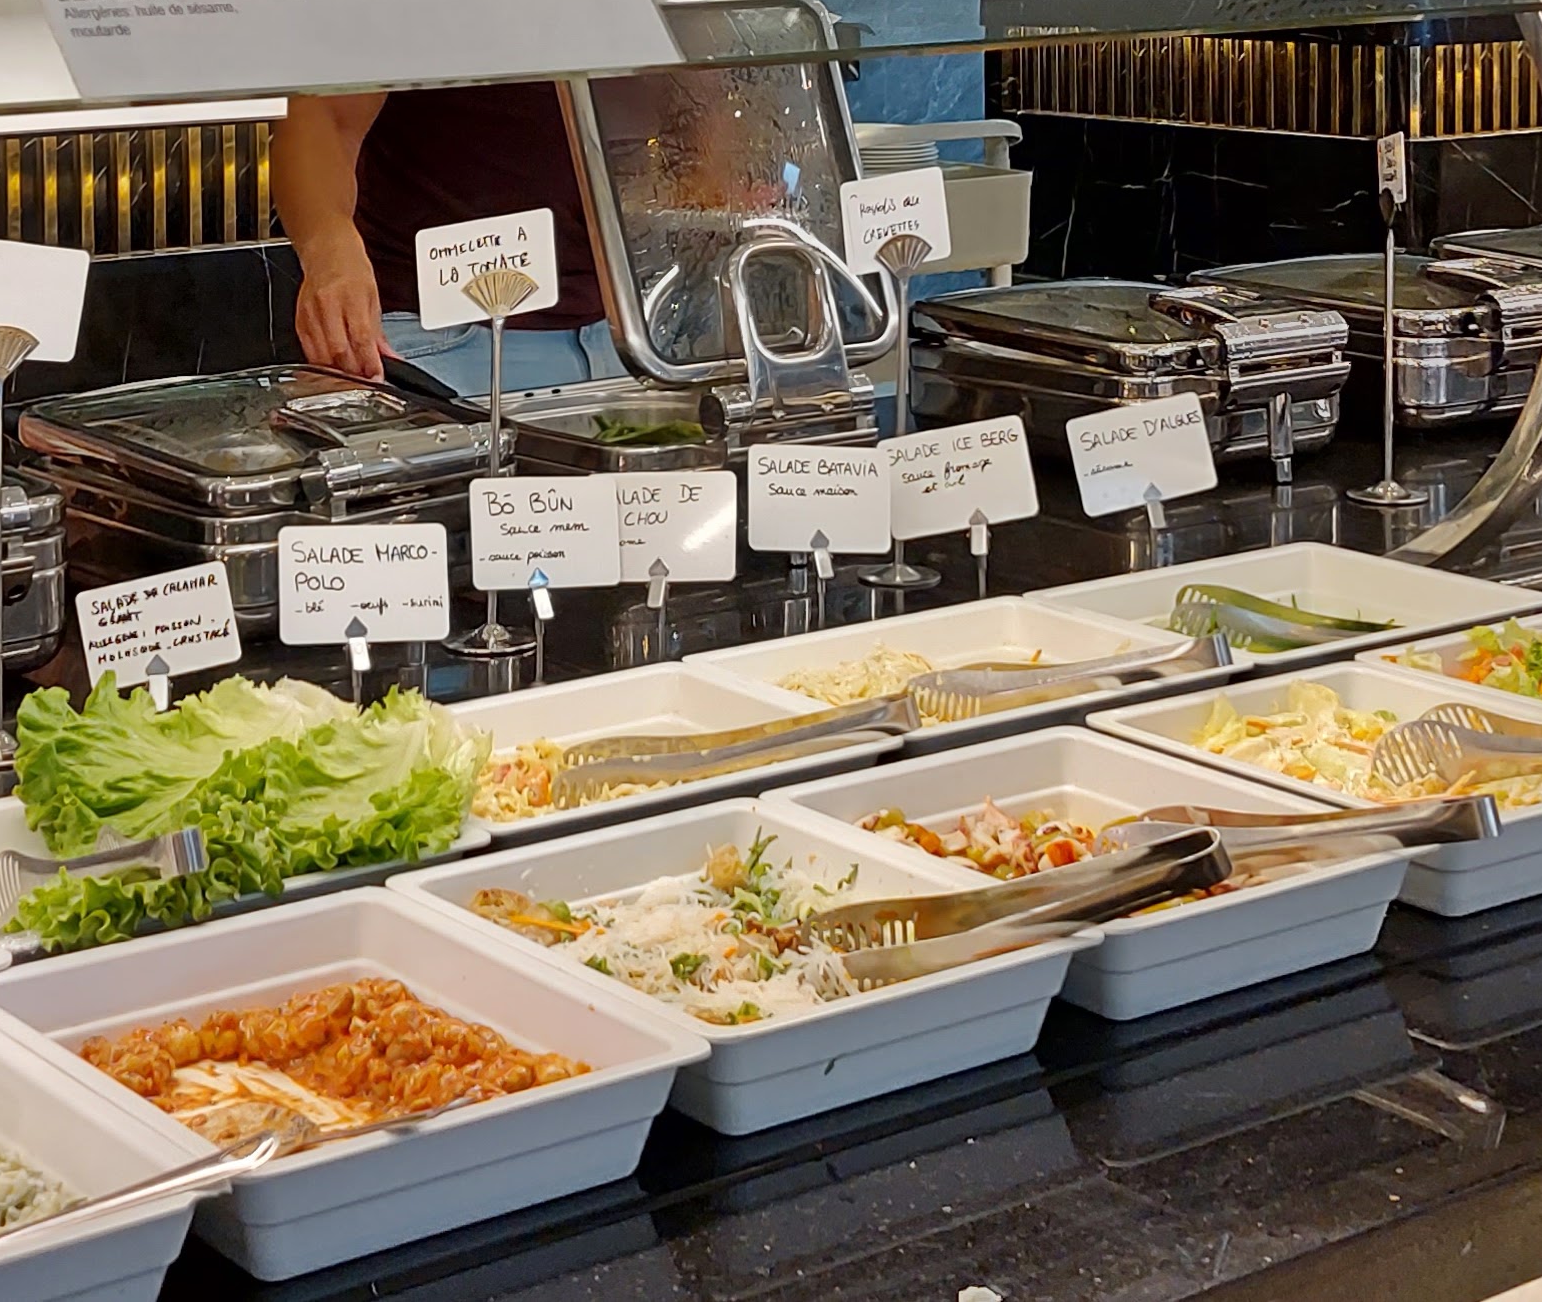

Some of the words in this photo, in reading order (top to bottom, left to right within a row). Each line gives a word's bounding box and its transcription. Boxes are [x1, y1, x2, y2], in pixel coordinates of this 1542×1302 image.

[133, 4, 167, 17] huile
[168, 3, 185, 16] de
[69, 24, 132, 38] moutarde
[517, 225, 528, 242] A
[979, 427, 1020, 448] BERG
[1079, 426, 1138, 452] SALADE
[1141, 409, 1202, 437] D'ALGUES
[757, 456, 812, 476] SALADE
[677, 483, 703, 504] DE
[812, 486, 859, 497] maison
[623, 509, 670, 527] CHOU
[291, 540, 365, 565] SALADE
[294, 570, 346, 593] POLO
[90, 590, 138, 616] SALADE
[162, 572, 219, 597] CALAMAR
